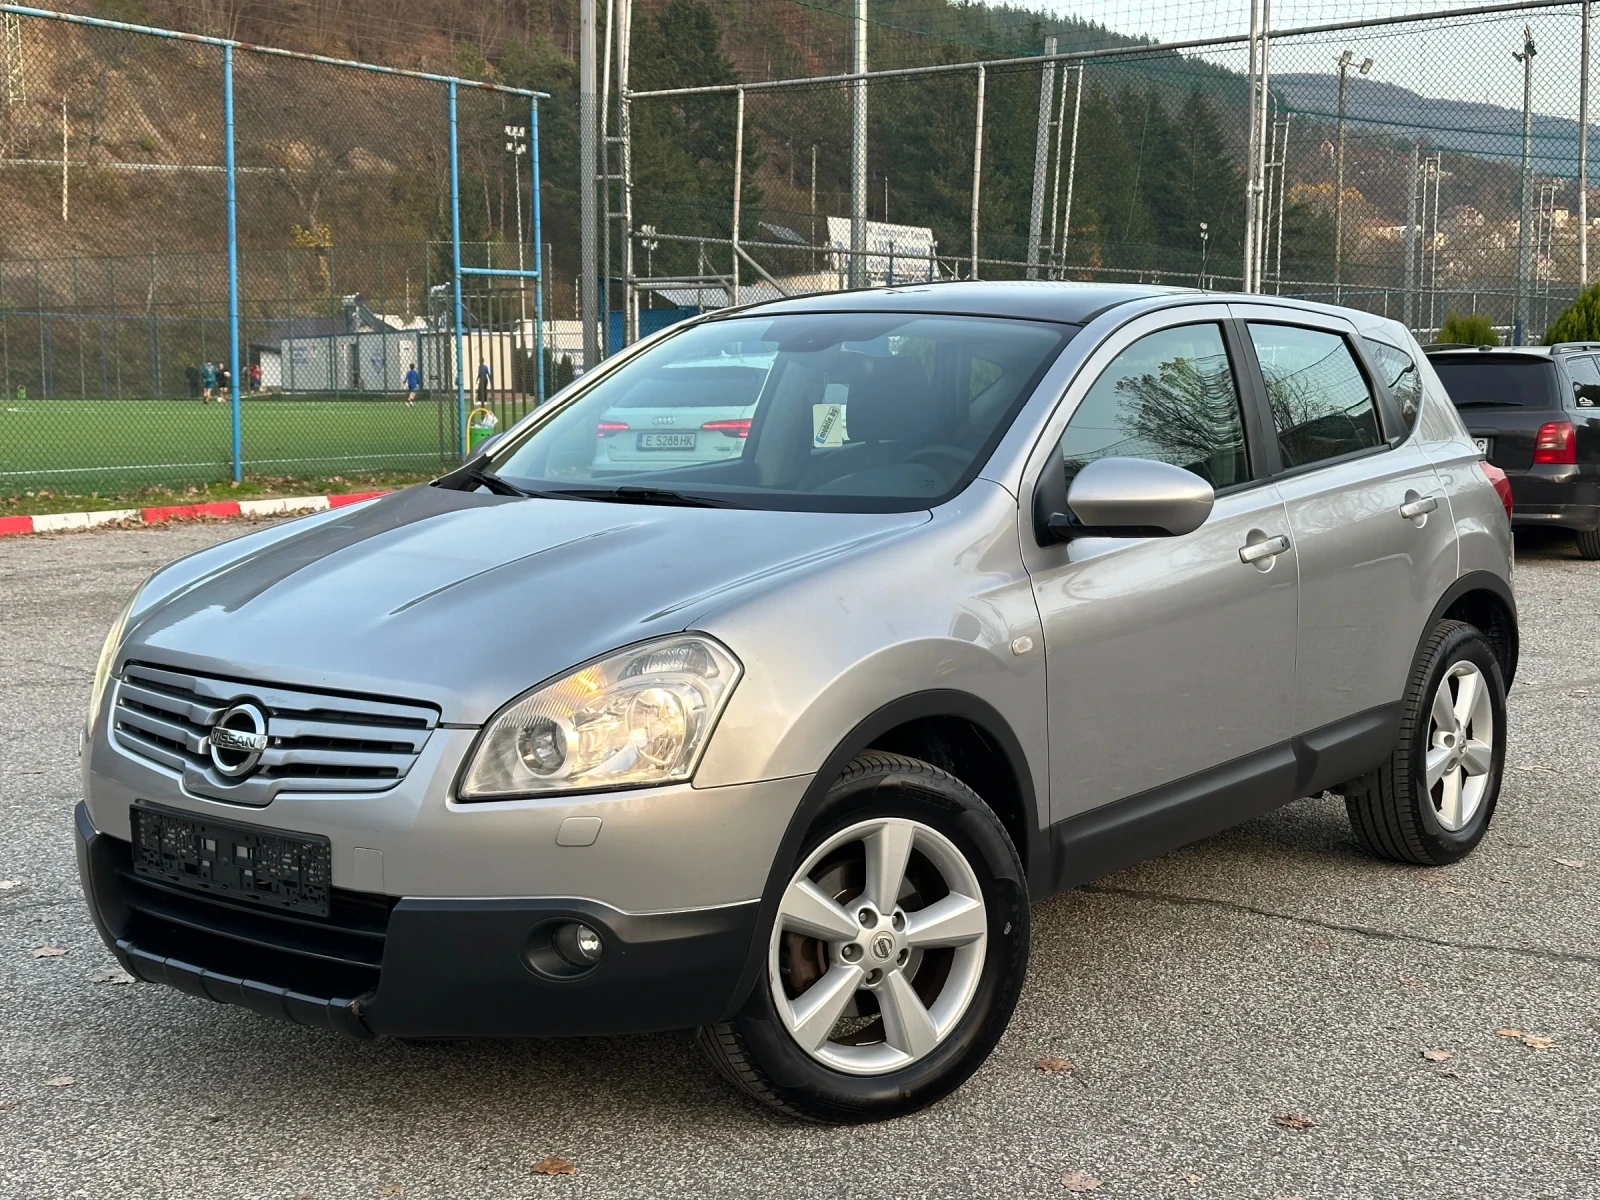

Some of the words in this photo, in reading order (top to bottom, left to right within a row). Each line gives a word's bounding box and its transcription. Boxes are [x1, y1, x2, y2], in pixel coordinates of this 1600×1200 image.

[820, 409, 839, 438] mobile.bg
[646, 436, 652, 446] E
[656, 436, 678, 446] 5288
[681, 436, 692, 446] HK
[210, 730, 257, 748] NISSAN
